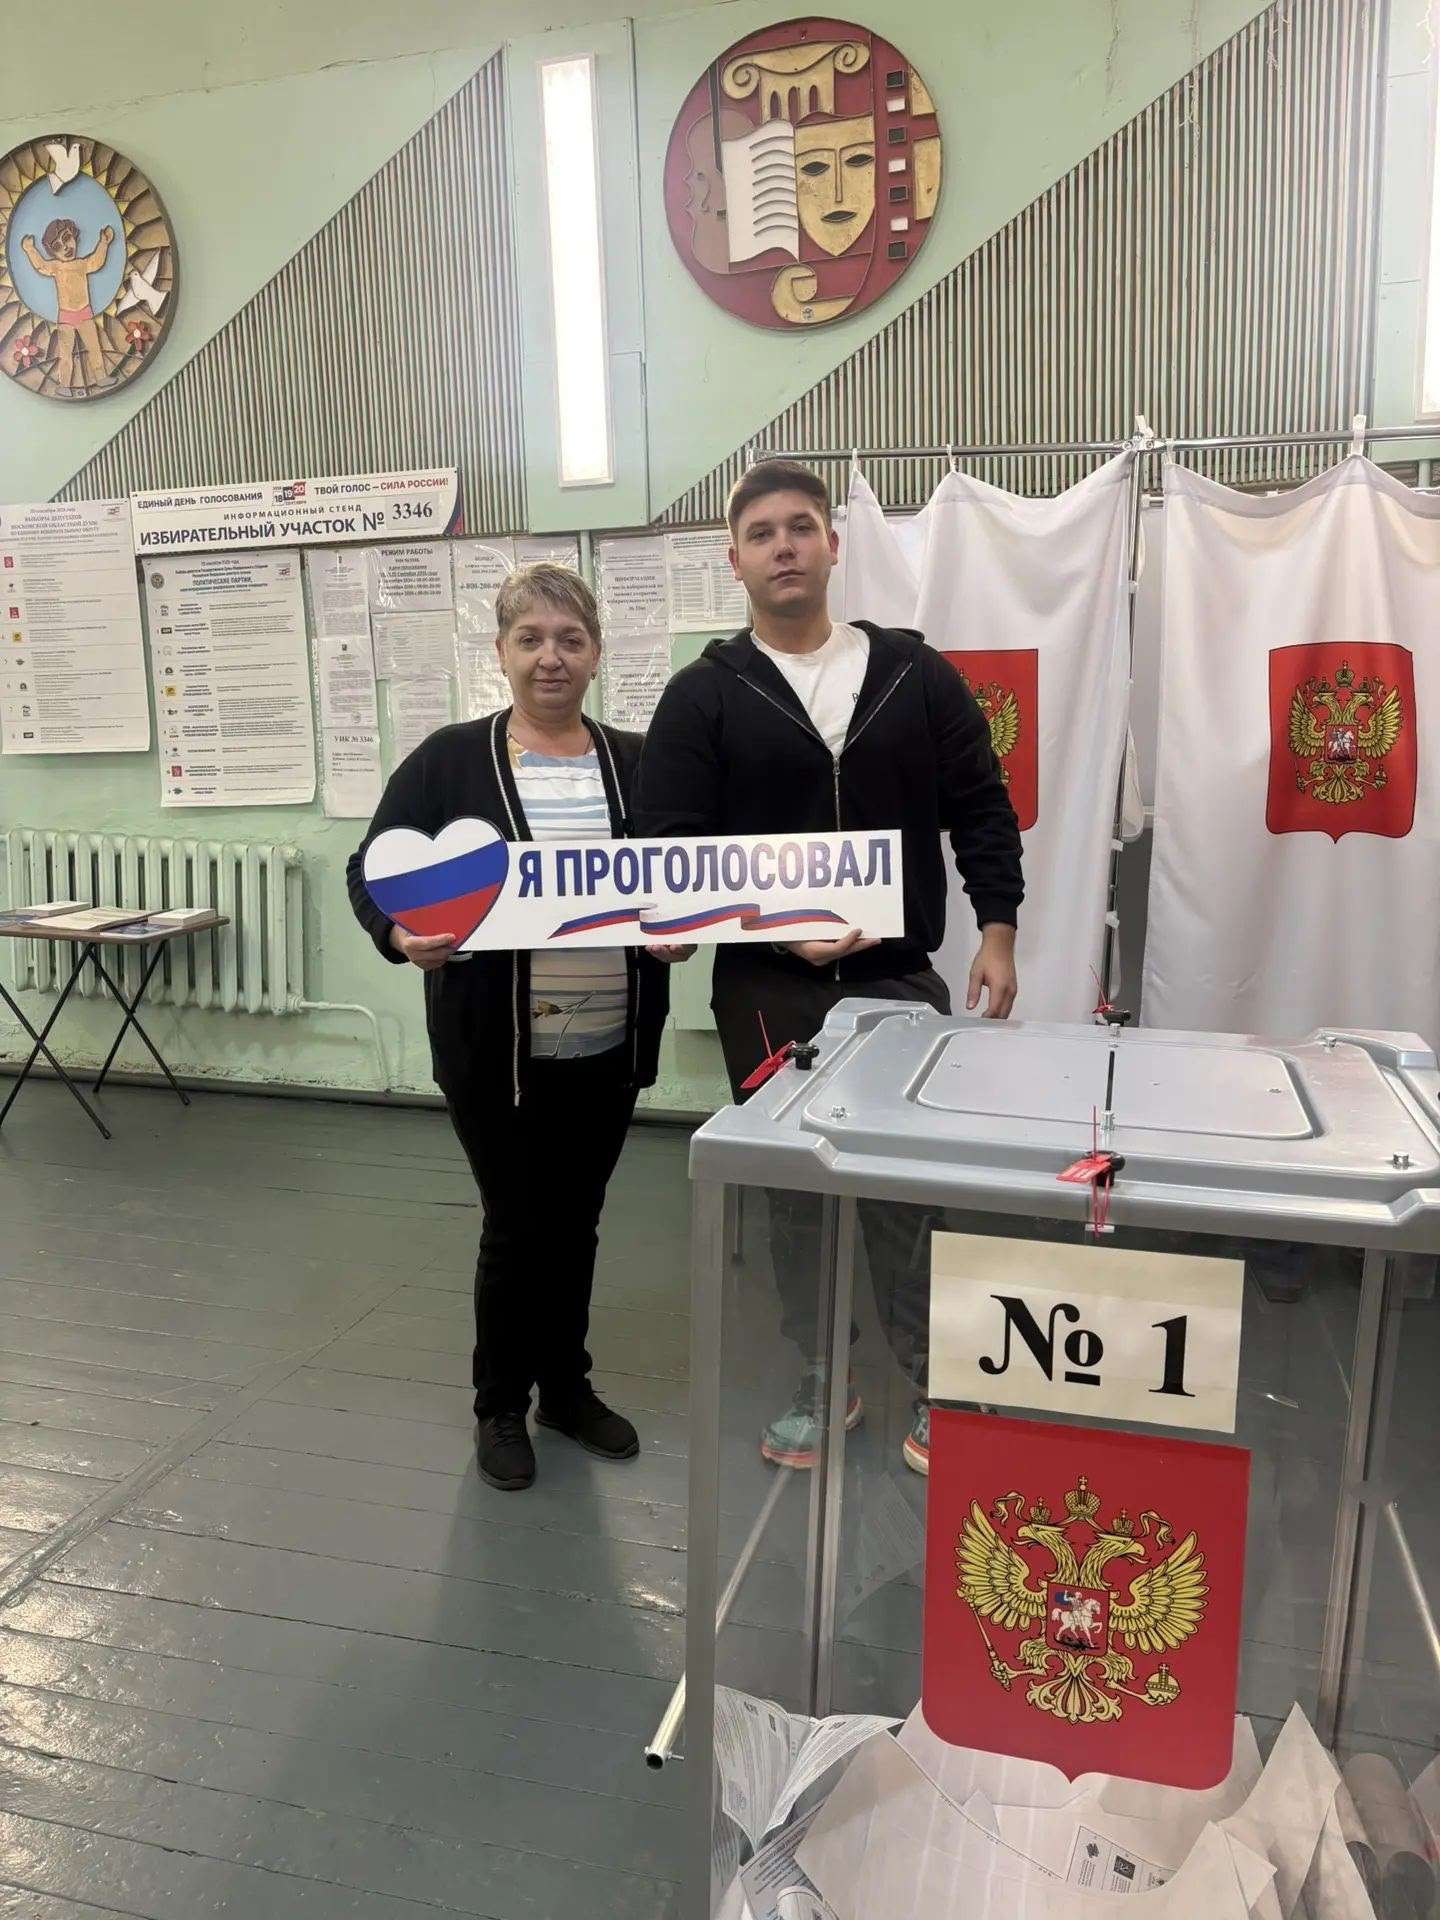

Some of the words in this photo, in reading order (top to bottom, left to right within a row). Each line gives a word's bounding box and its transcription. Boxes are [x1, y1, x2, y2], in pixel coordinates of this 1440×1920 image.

[284, 490, 293, 498] 19
[294, 485, 304, 493] 20
[314, 484, 339, 495] ТВОЙ
[340, 483, 371, 493] ГОЛОС
[380, 481, 406, 491] СИЛА
[407, 478, 449, 488] РОССИИ!
[138, 497, 172, 509] ЕДИНЫЙ
[174, 496, 196, 507] ДЕНЬ
[200, 492, 263, 504] ГОЛОСОВАНИЯ
[275, 495, 283, 503] 18
[224, 506, 325, 520] ИНФОРМАЦИОННЫЙ
[329, 504, 362, 513] СТЕНД
[140, 521, 275, 546] ИЗБИРАТЕЛЬНЫЙ
[280, 518, 355, 537] УЧАСТОК
[362, 512, 384, 531] №
[392, 501, 433, 520] 3346
[381, 548, 405, 556] РЕЖИМ
[517, 850, 543, 898] Я
[556, 837, 891, 897] ПРОГОЛОСОВАЛ
[979, 1294, 1104, 1386] №
[1148, 1315, 1196, 1398] 1
